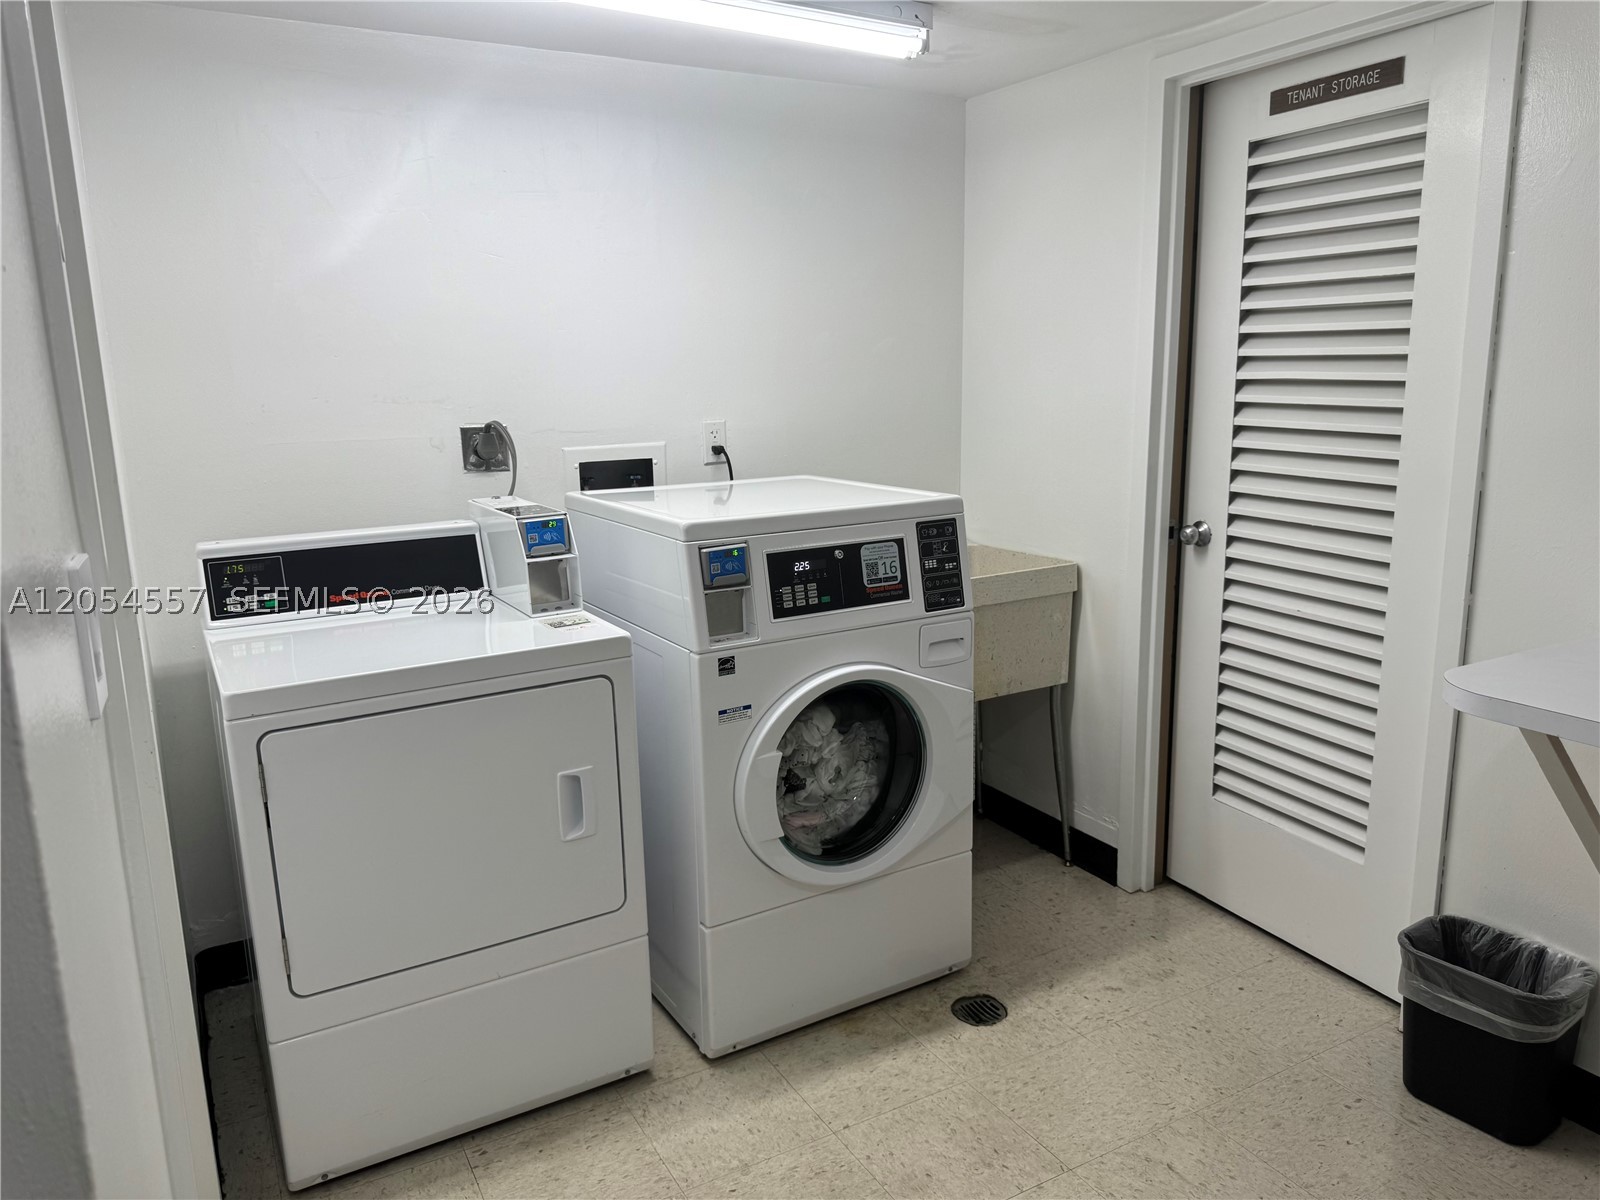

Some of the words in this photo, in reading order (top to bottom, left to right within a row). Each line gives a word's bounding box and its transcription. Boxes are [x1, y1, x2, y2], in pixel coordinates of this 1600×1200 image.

[1287, 83, 1325, 104] TENANT
[1331, 69, 1381, 94] STORAGE
[881, 560, 898, 575] 16
